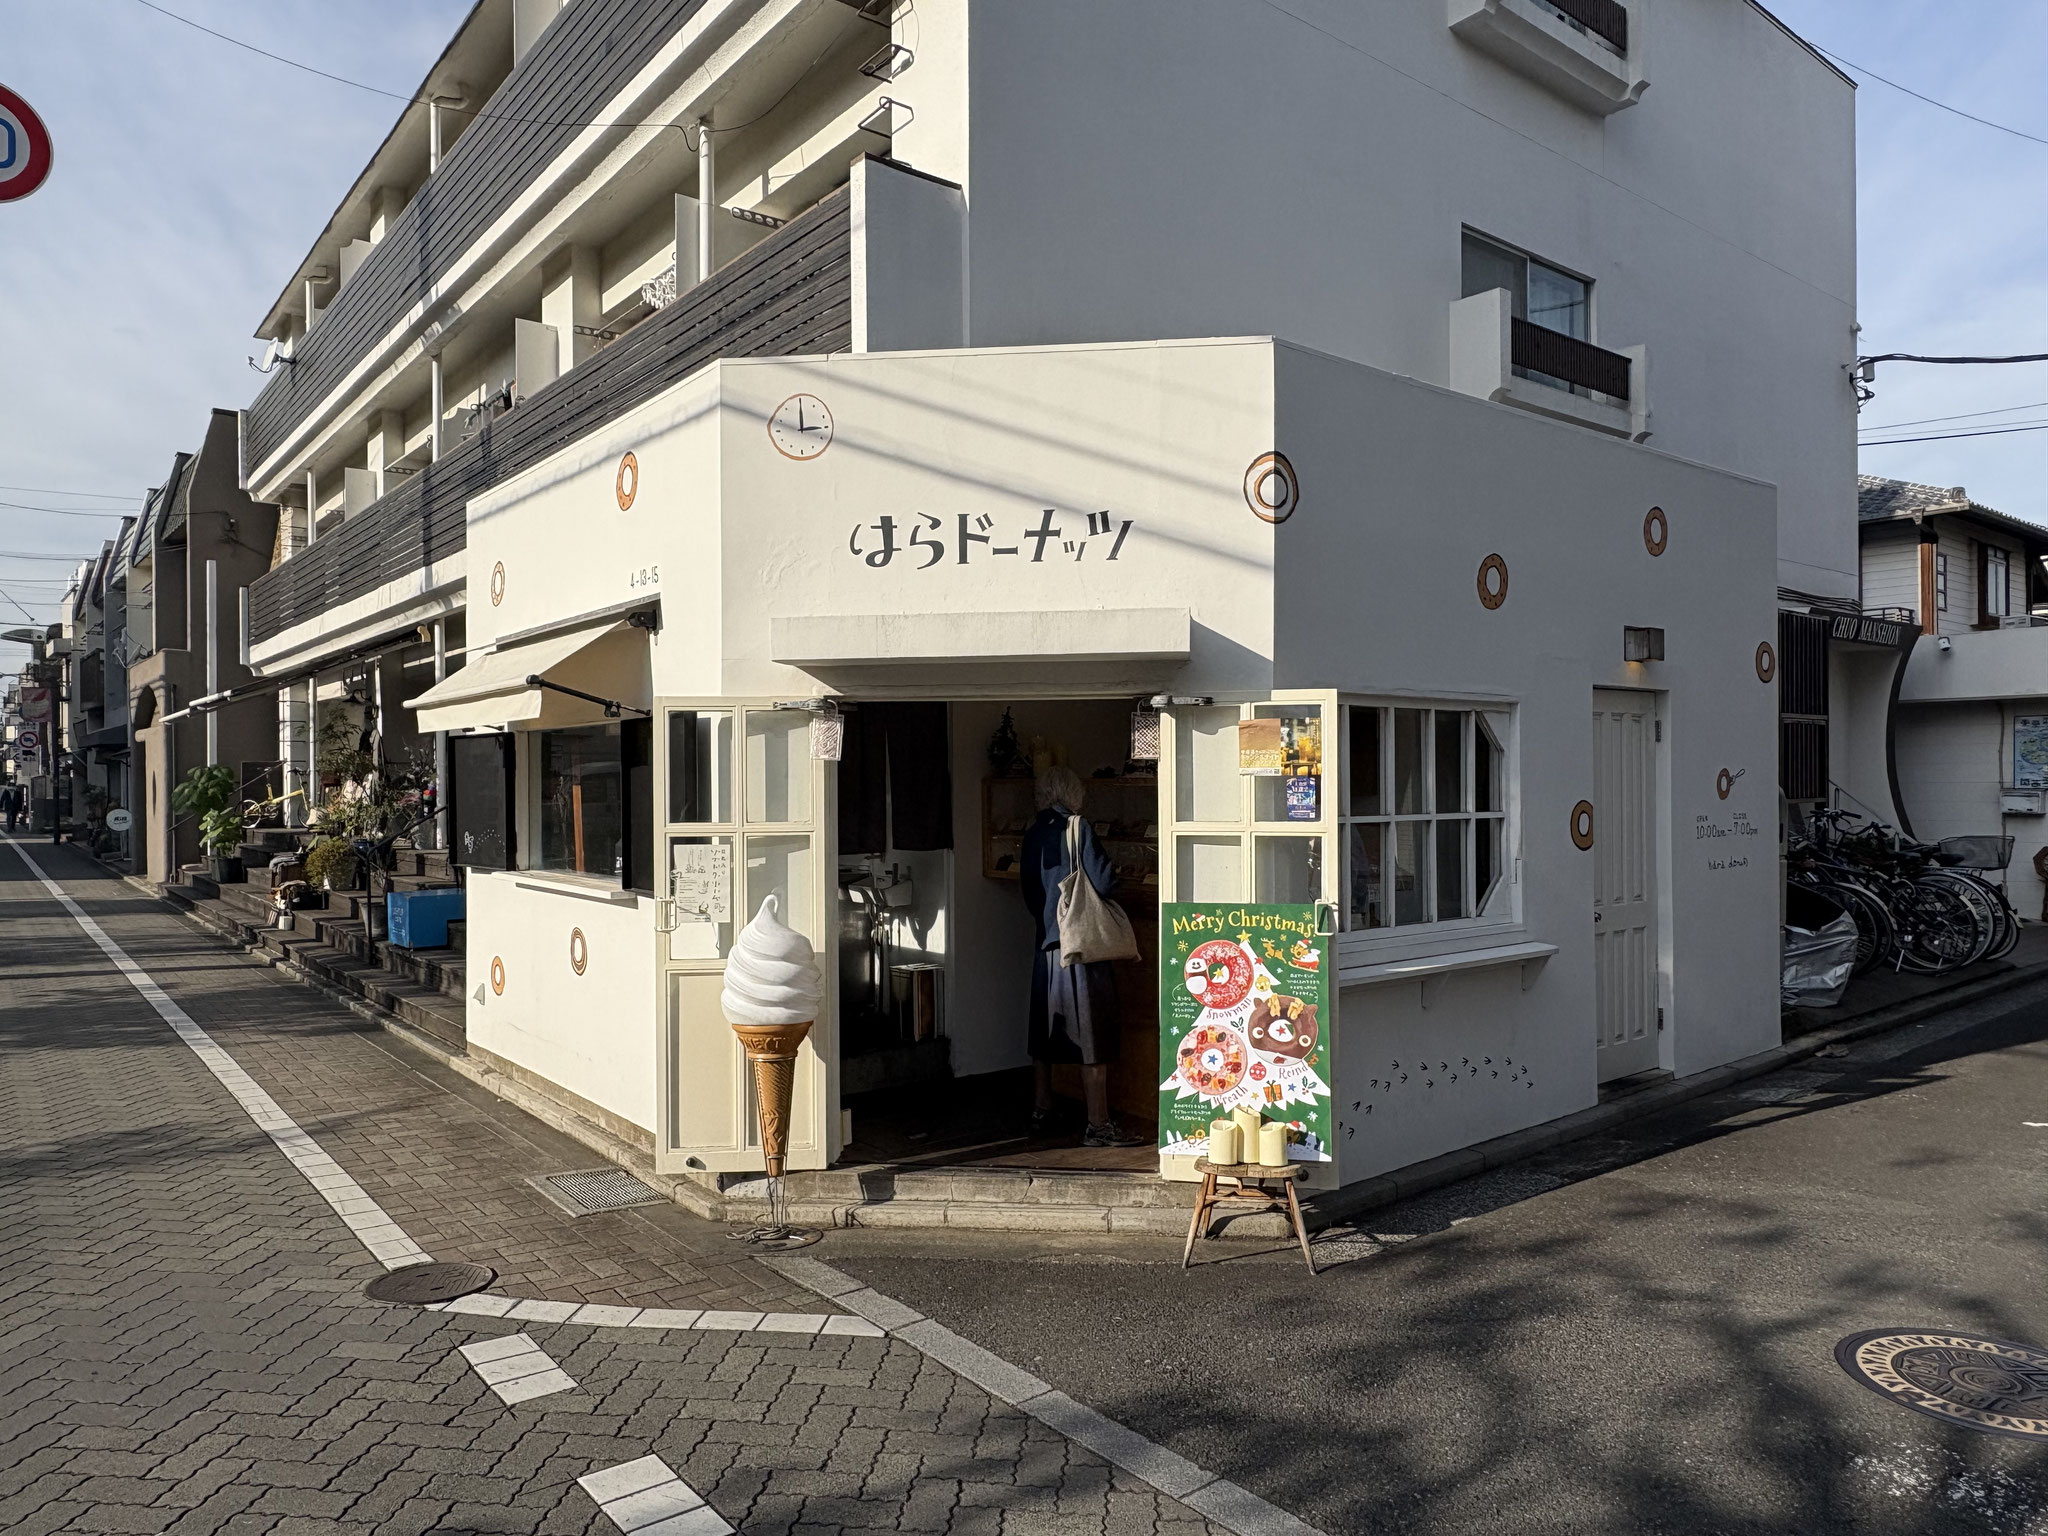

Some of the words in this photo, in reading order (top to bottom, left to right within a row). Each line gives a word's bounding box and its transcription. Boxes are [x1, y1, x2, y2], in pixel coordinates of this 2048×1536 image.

[849, 508, 1134, 570] はらドーナッツ
[630, 565, 659, 589] 4-13-15
[1832, 615, 1858, 640] CHUO
[1858, 620, 1901, 645] MANSHION
[1172, 915, 1225, 935] Merry
[1206, 997, 1252, 1020] Snowman
[1212, 1085, 1249, 1105] Wreath
